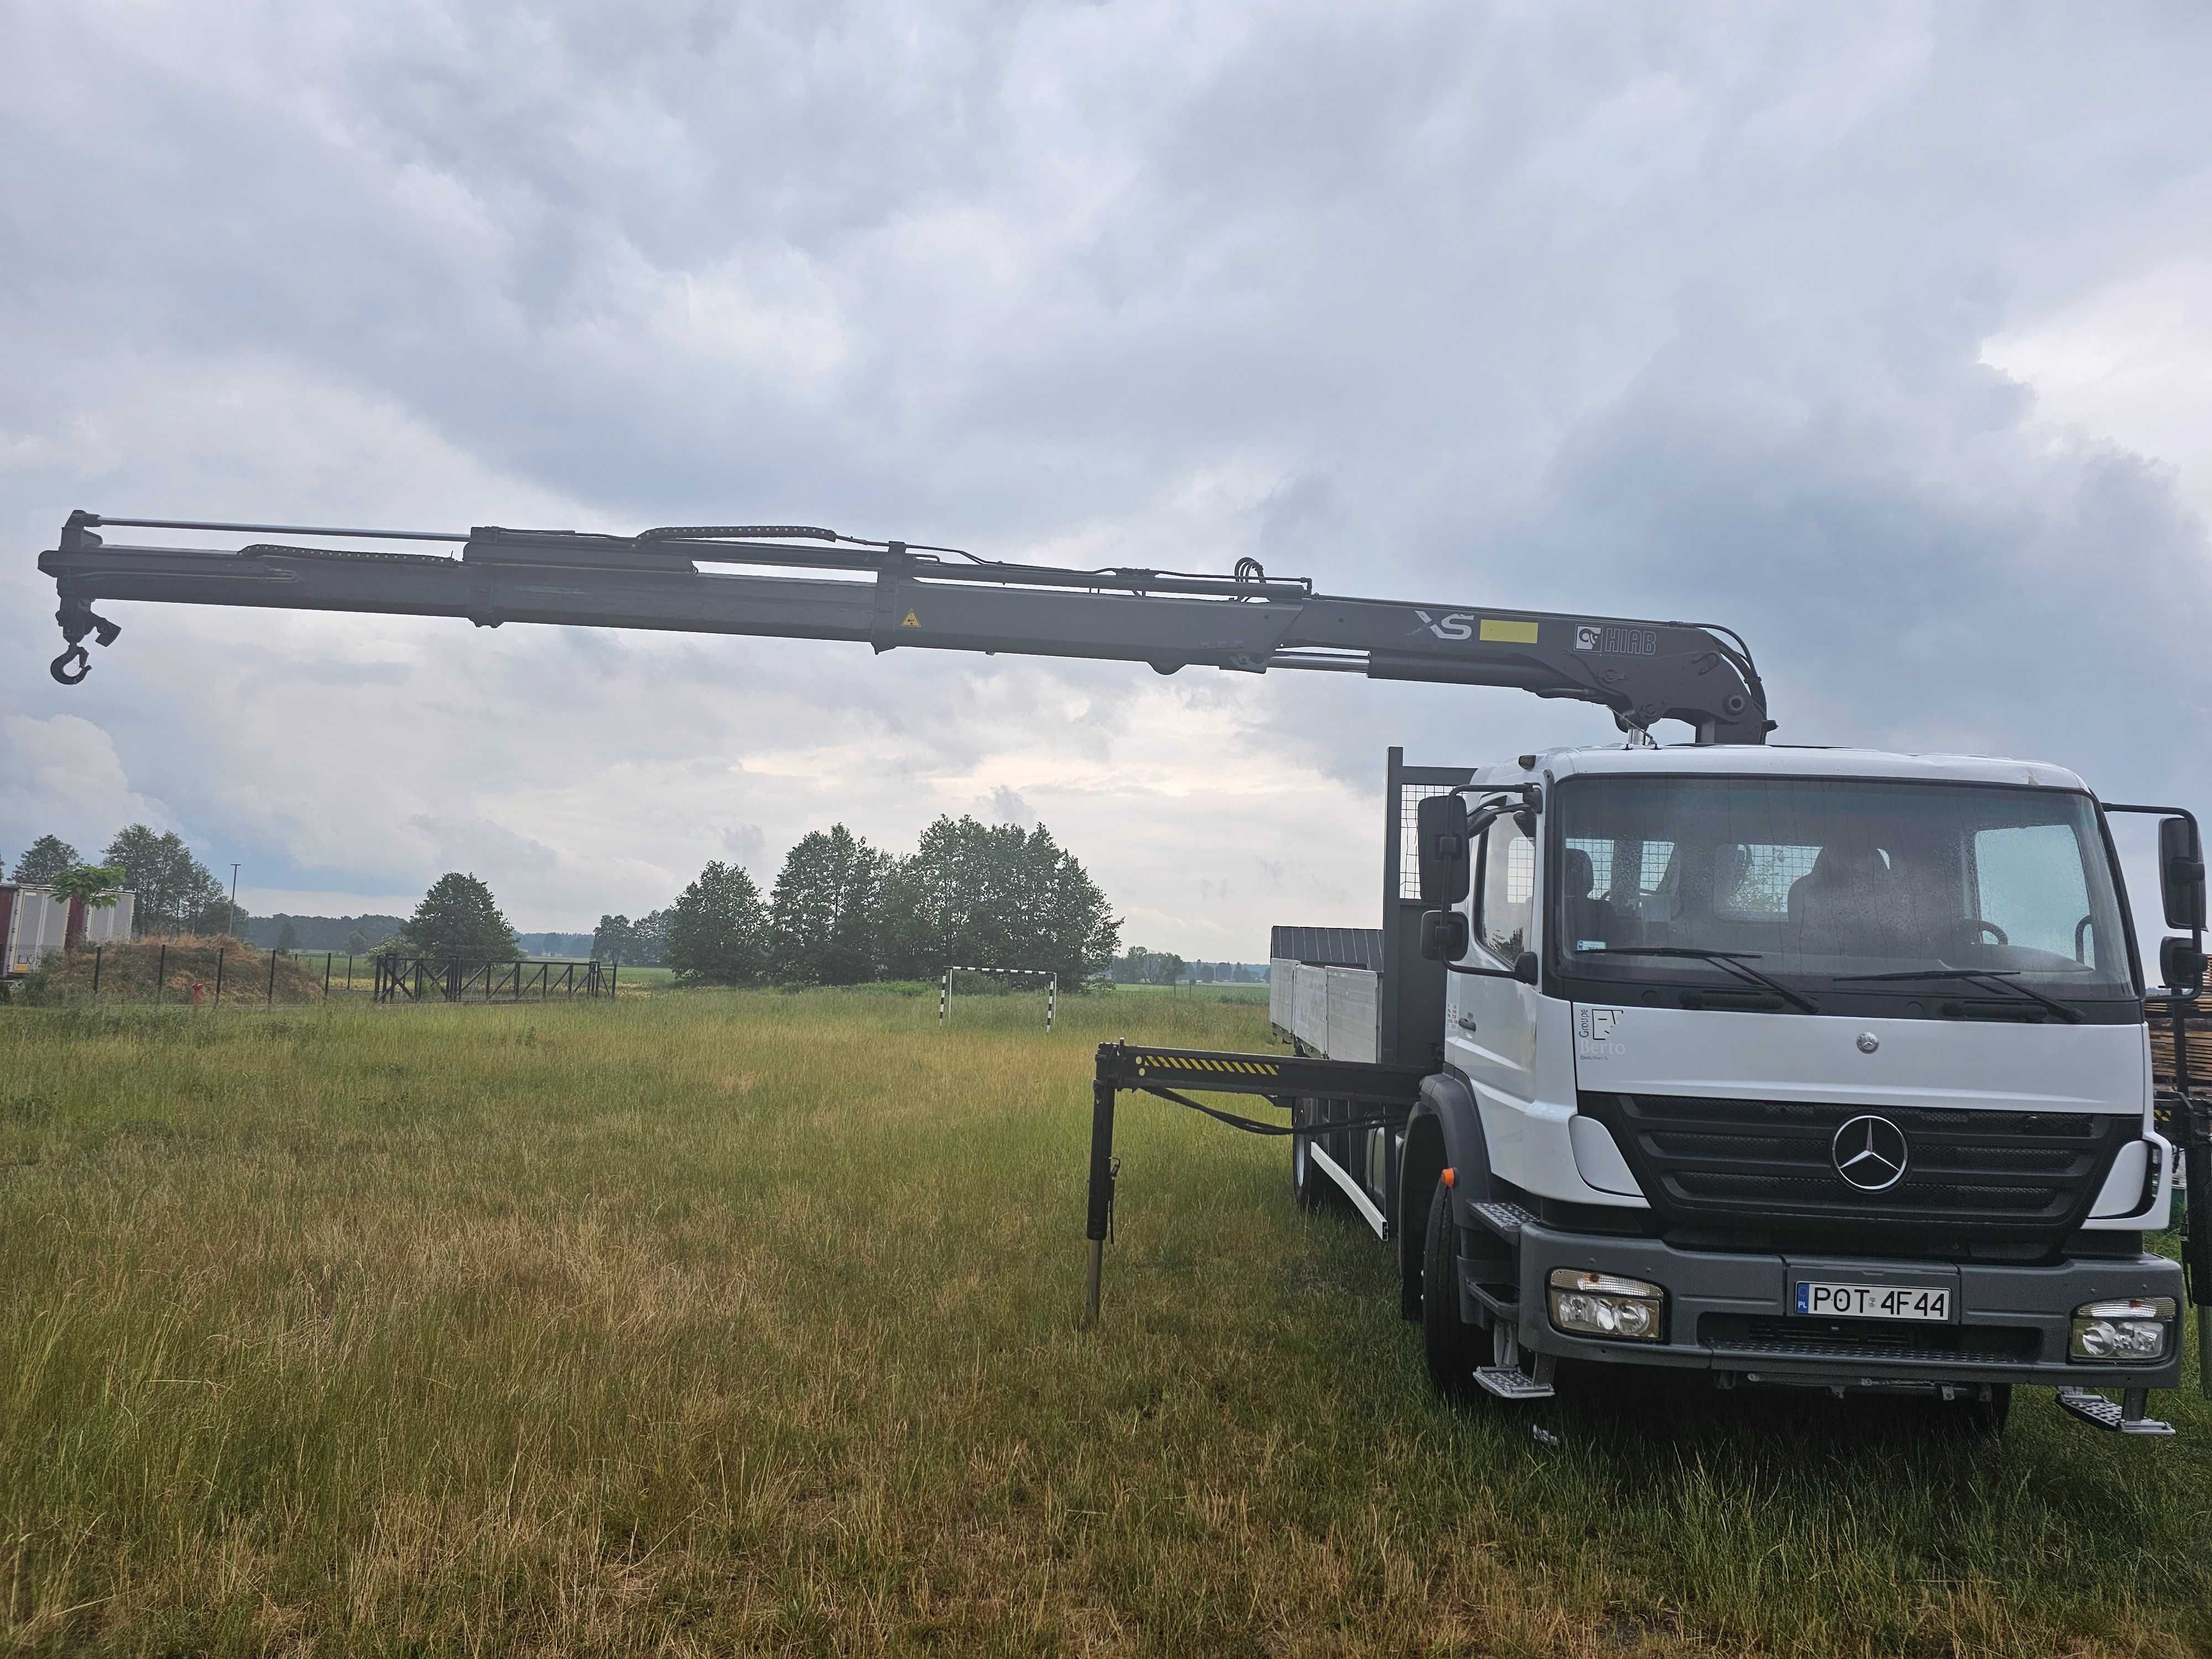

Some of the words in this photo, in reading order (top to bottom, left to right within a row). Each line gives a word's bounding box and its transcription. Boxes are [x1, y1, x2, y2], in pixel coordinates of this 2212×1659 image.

[1411, 610, 1475, 640] XS
[1605, 628, 1657, 655] HIAB
[1578, 1008, 1590, 1038] Groupe
[1580, 1039, 1626, 1055] Berto
[1798, 1301, 1808, 1309] PL
[1813, 1287, 1870, 1313] POT
[1880, 1290, 1945, 1317] 4F44
